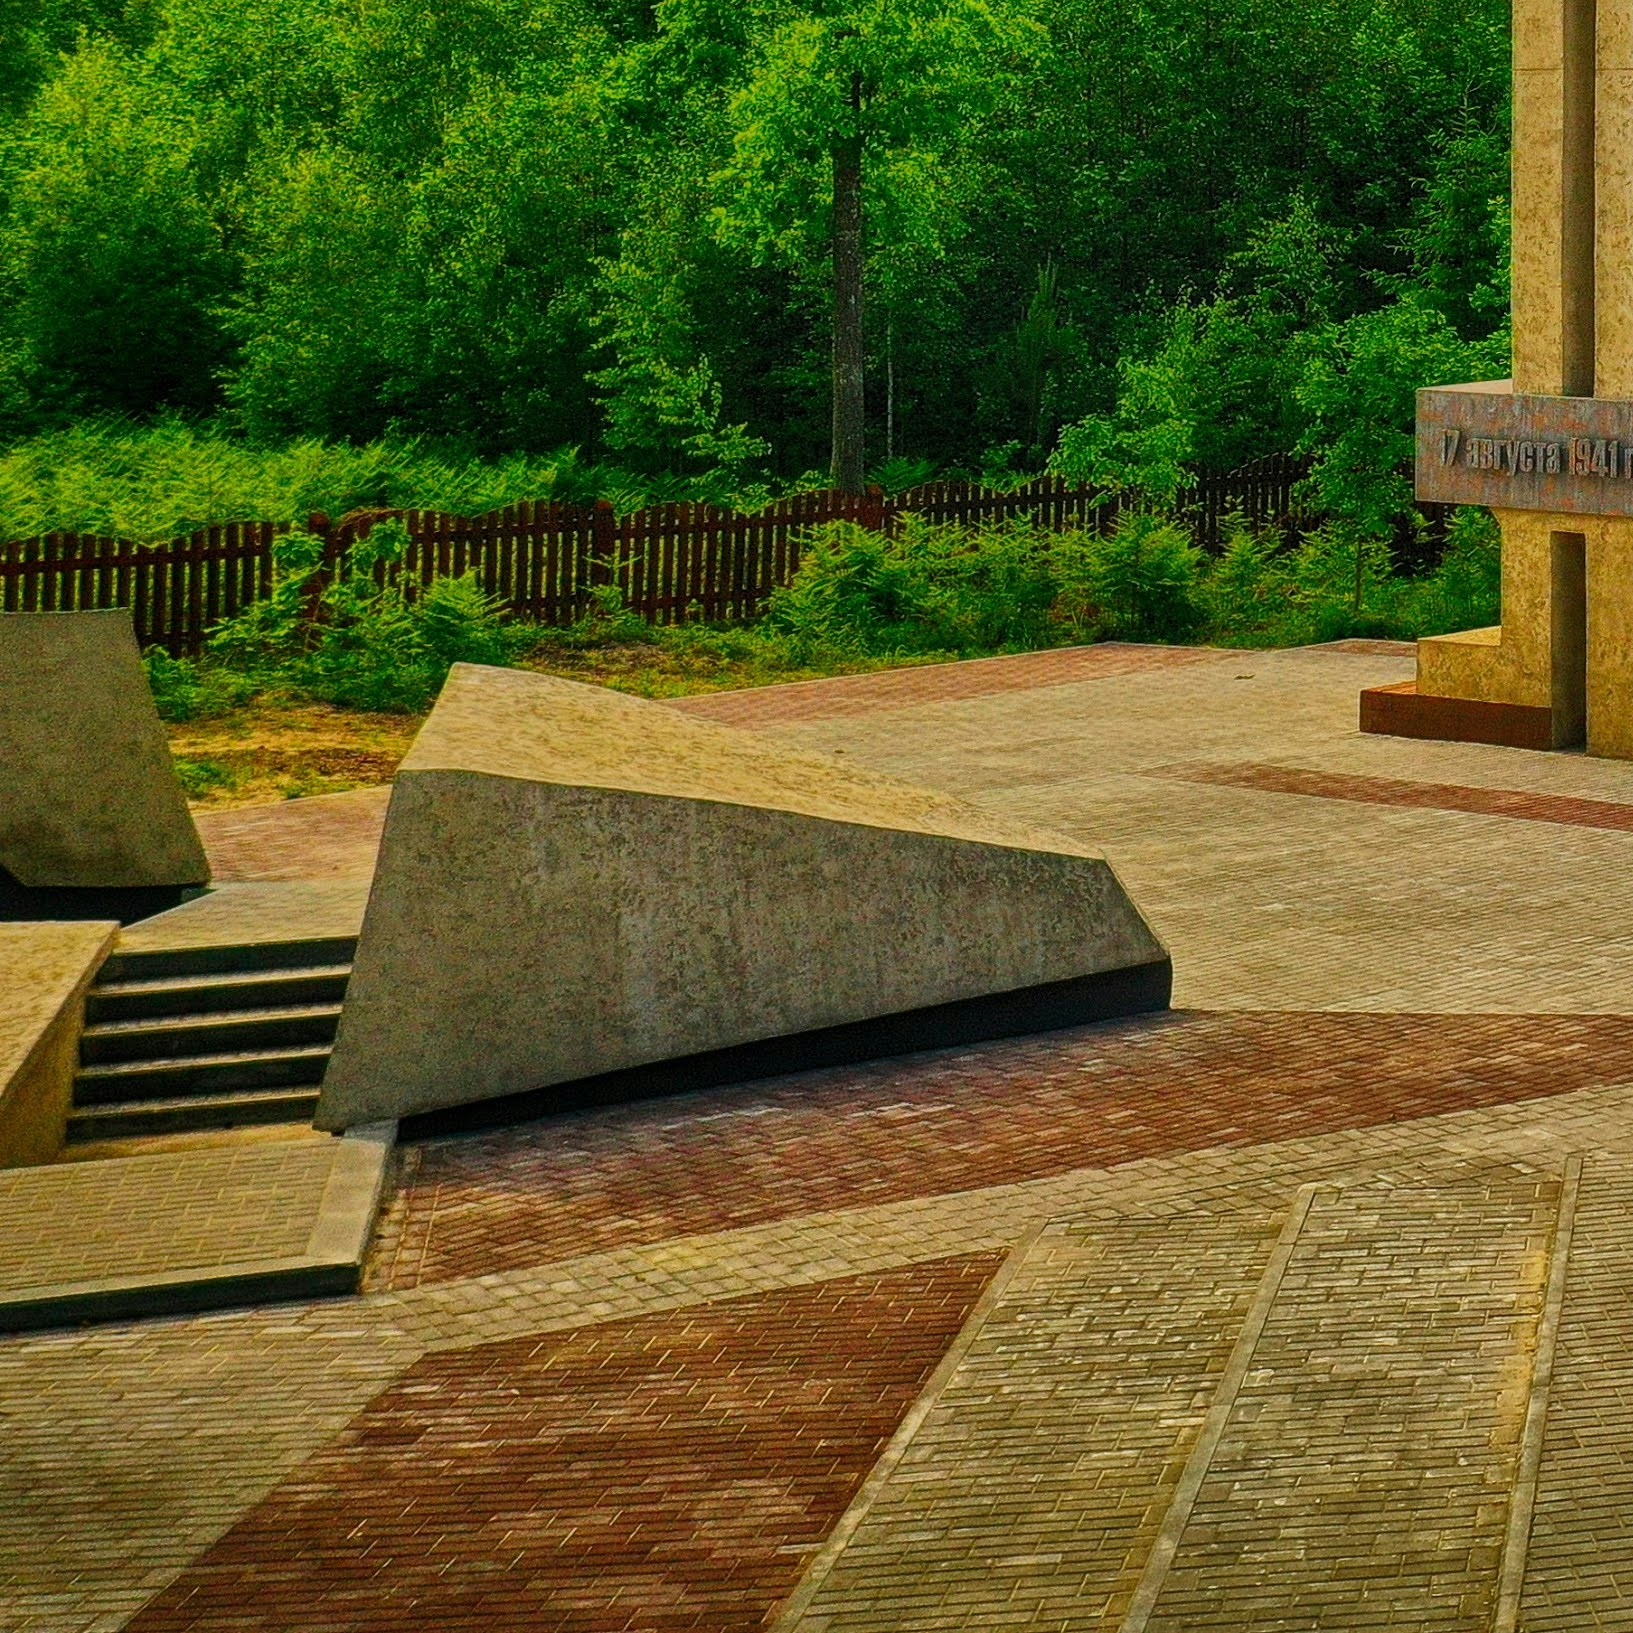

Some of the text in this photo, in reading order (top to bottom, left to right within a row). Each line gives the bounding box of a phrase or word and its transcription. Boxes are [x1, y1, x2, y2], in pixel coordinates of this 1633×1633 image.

[1438, 428, 1461, 468] 17
[1465, 436, 1562, 477] августа
[1568, 435, 1619, 479] 1941
